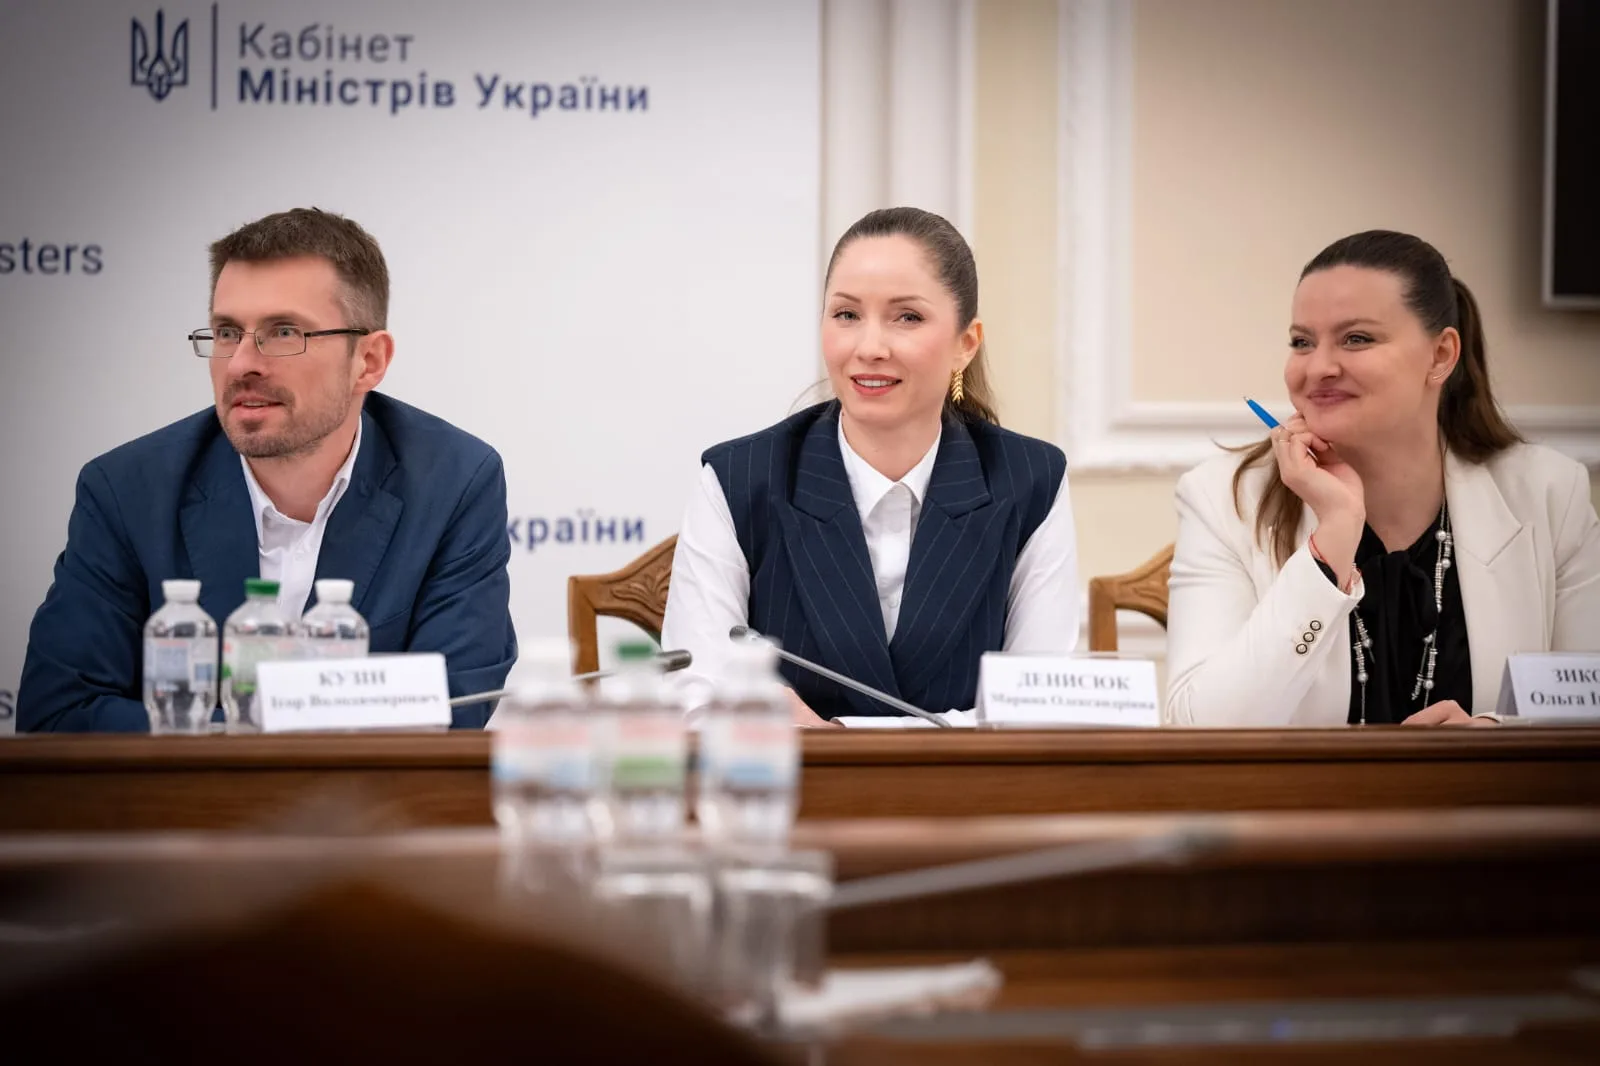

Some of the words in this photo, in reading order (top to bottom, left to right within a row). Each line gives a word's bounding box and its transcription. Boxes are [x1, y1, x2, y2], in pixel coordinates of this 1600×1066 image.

[239, 22, 414, 62] Кабінет
[239, 67, 456, 115] Міністрів
[474, 73, 649, 118] України
[1017, 672, 1131, 691] ДЕНИСЮК
[1530, 691, 1585, 706] Ольга
